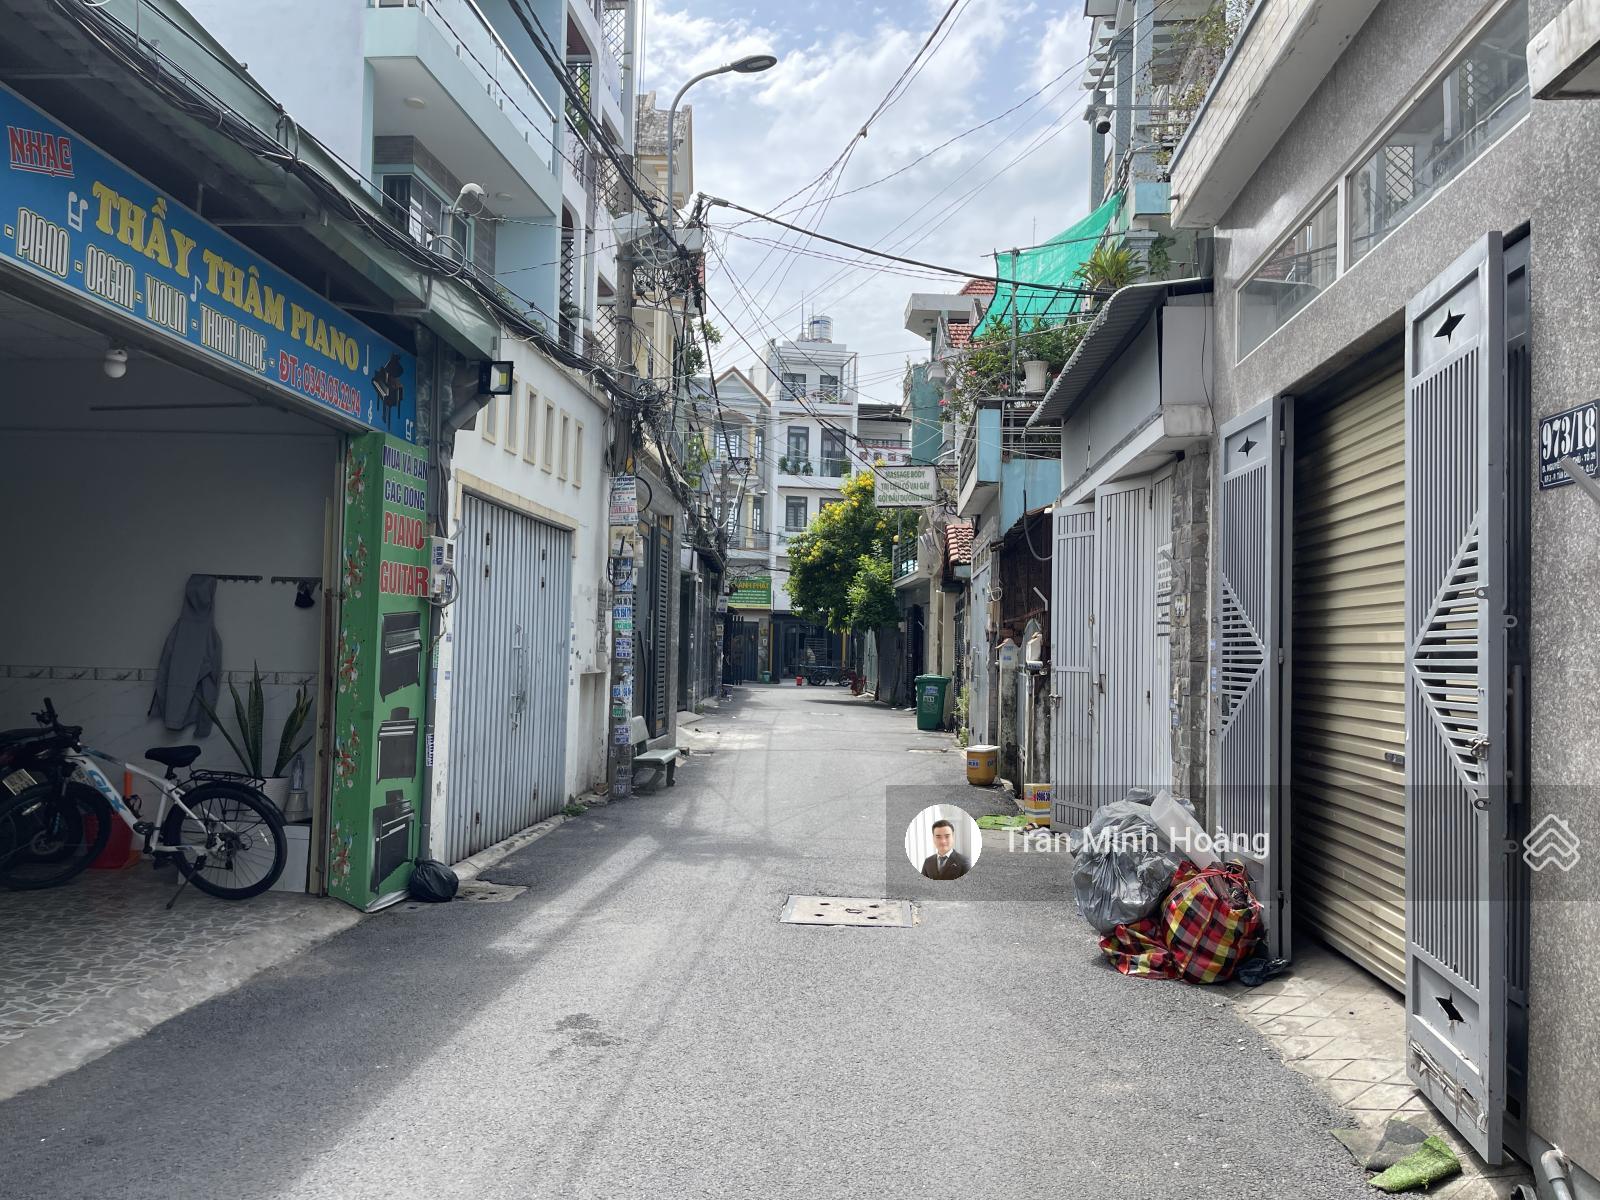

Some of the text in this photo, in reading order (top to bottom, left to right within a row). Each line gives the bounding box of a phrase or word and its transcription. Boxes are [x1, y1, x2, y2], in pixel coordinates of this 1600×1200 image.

[16, 206, 71, 278] PIANO
[85, 243, 135, 312] ORGAN
[145, 273, 188, 337] VIOLIN
[200, 302, 238, 360] THANH
[239, 324, 267, 374] NHẠC
[92, 181, 360, 371] THẦY THÂM PIANO
[1542, 407, 1596, 460] 973/18
[383, 445, 400, 470] MUA
[885, 470, 926, 479] MASSAGE BODY
[383, 510, 426, 550] PIANO
[379, 560, 430, 598] GUITAR
